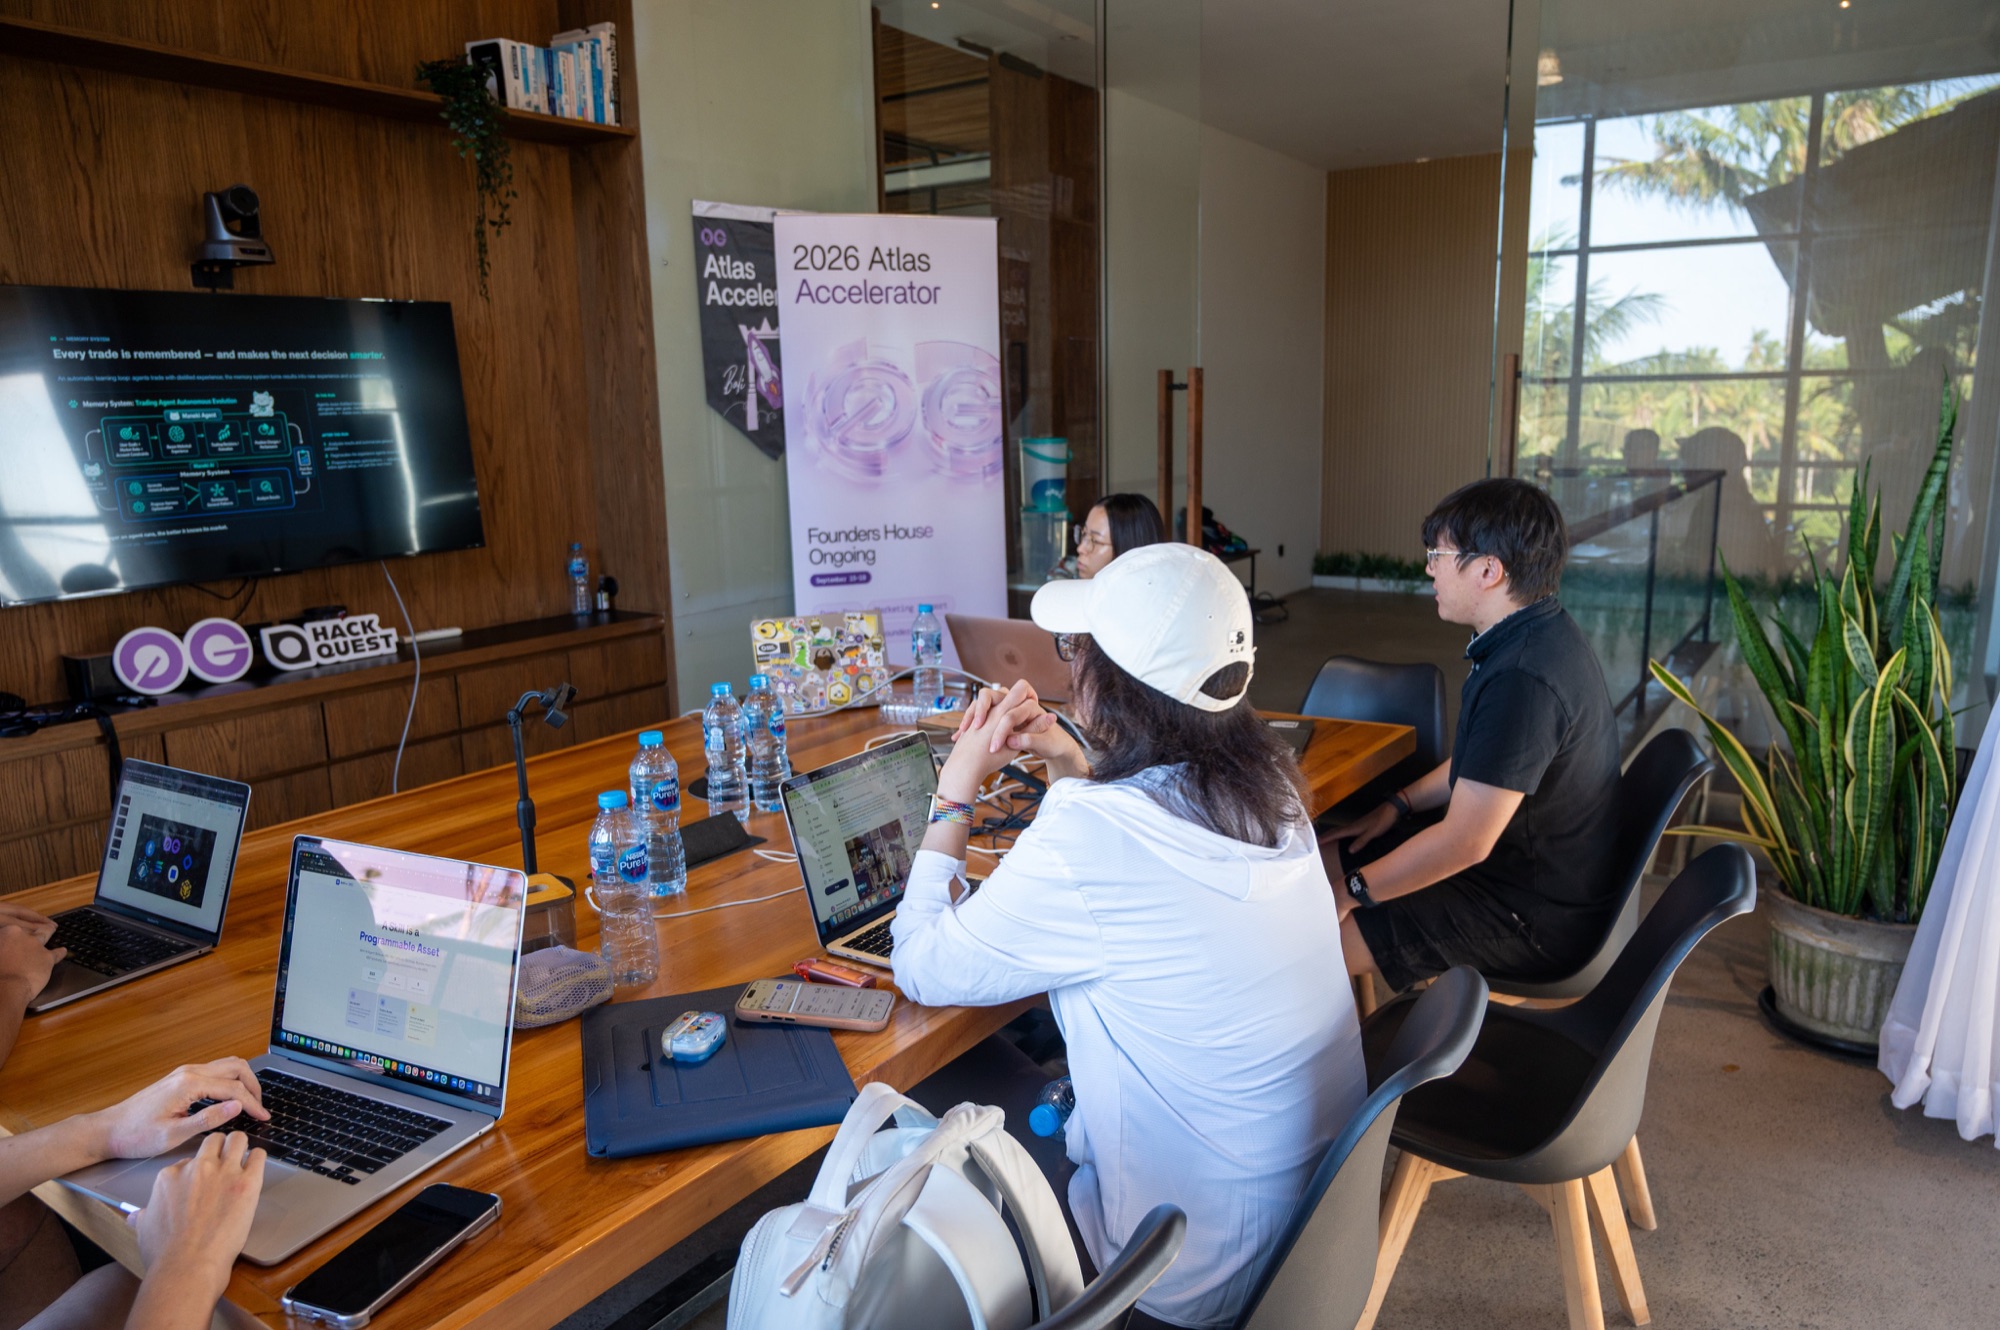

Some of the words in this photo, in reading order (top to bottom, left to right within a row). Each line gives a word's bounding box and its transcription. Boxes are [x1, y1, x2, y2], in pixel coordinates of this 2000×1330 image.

[703, 254, 756, 280] Atlas
[793, 244, 860, 271] 2026
[868, 246, 931, 272] Atlas
[795, 278, 941, 304] Accelerator
[53, 349, 86, 361] Every
[88, 349, 119, 359] trade
[121, 349, 131, 359] is
[133, 349, 201, 359] remembered
[216, 350, 236, 360] and
[237, 350, 270, 360] makes
[271, 350, 287, 360] the
[288, 350, 310, 360] next
[310, 350, 348, 360] decision
[349, 350, 386, 360] smarter.
[82, 400, 108, 409] Memory
[135, 399, 158, 407] Trading
[206, 469, 231, 477] System
[808, 525, 881, 544] Founders
[884, 523, 934, 541] House
[809, 546, 876, 568] Ongoing
[312, 619, 377, 642] HACK
[317, 633, 393, 659] QUEST
[619, 859, 641, 871] Pure
[360, 931, 416, 951] Programmable
[416, 943, 440, 957] Asset
